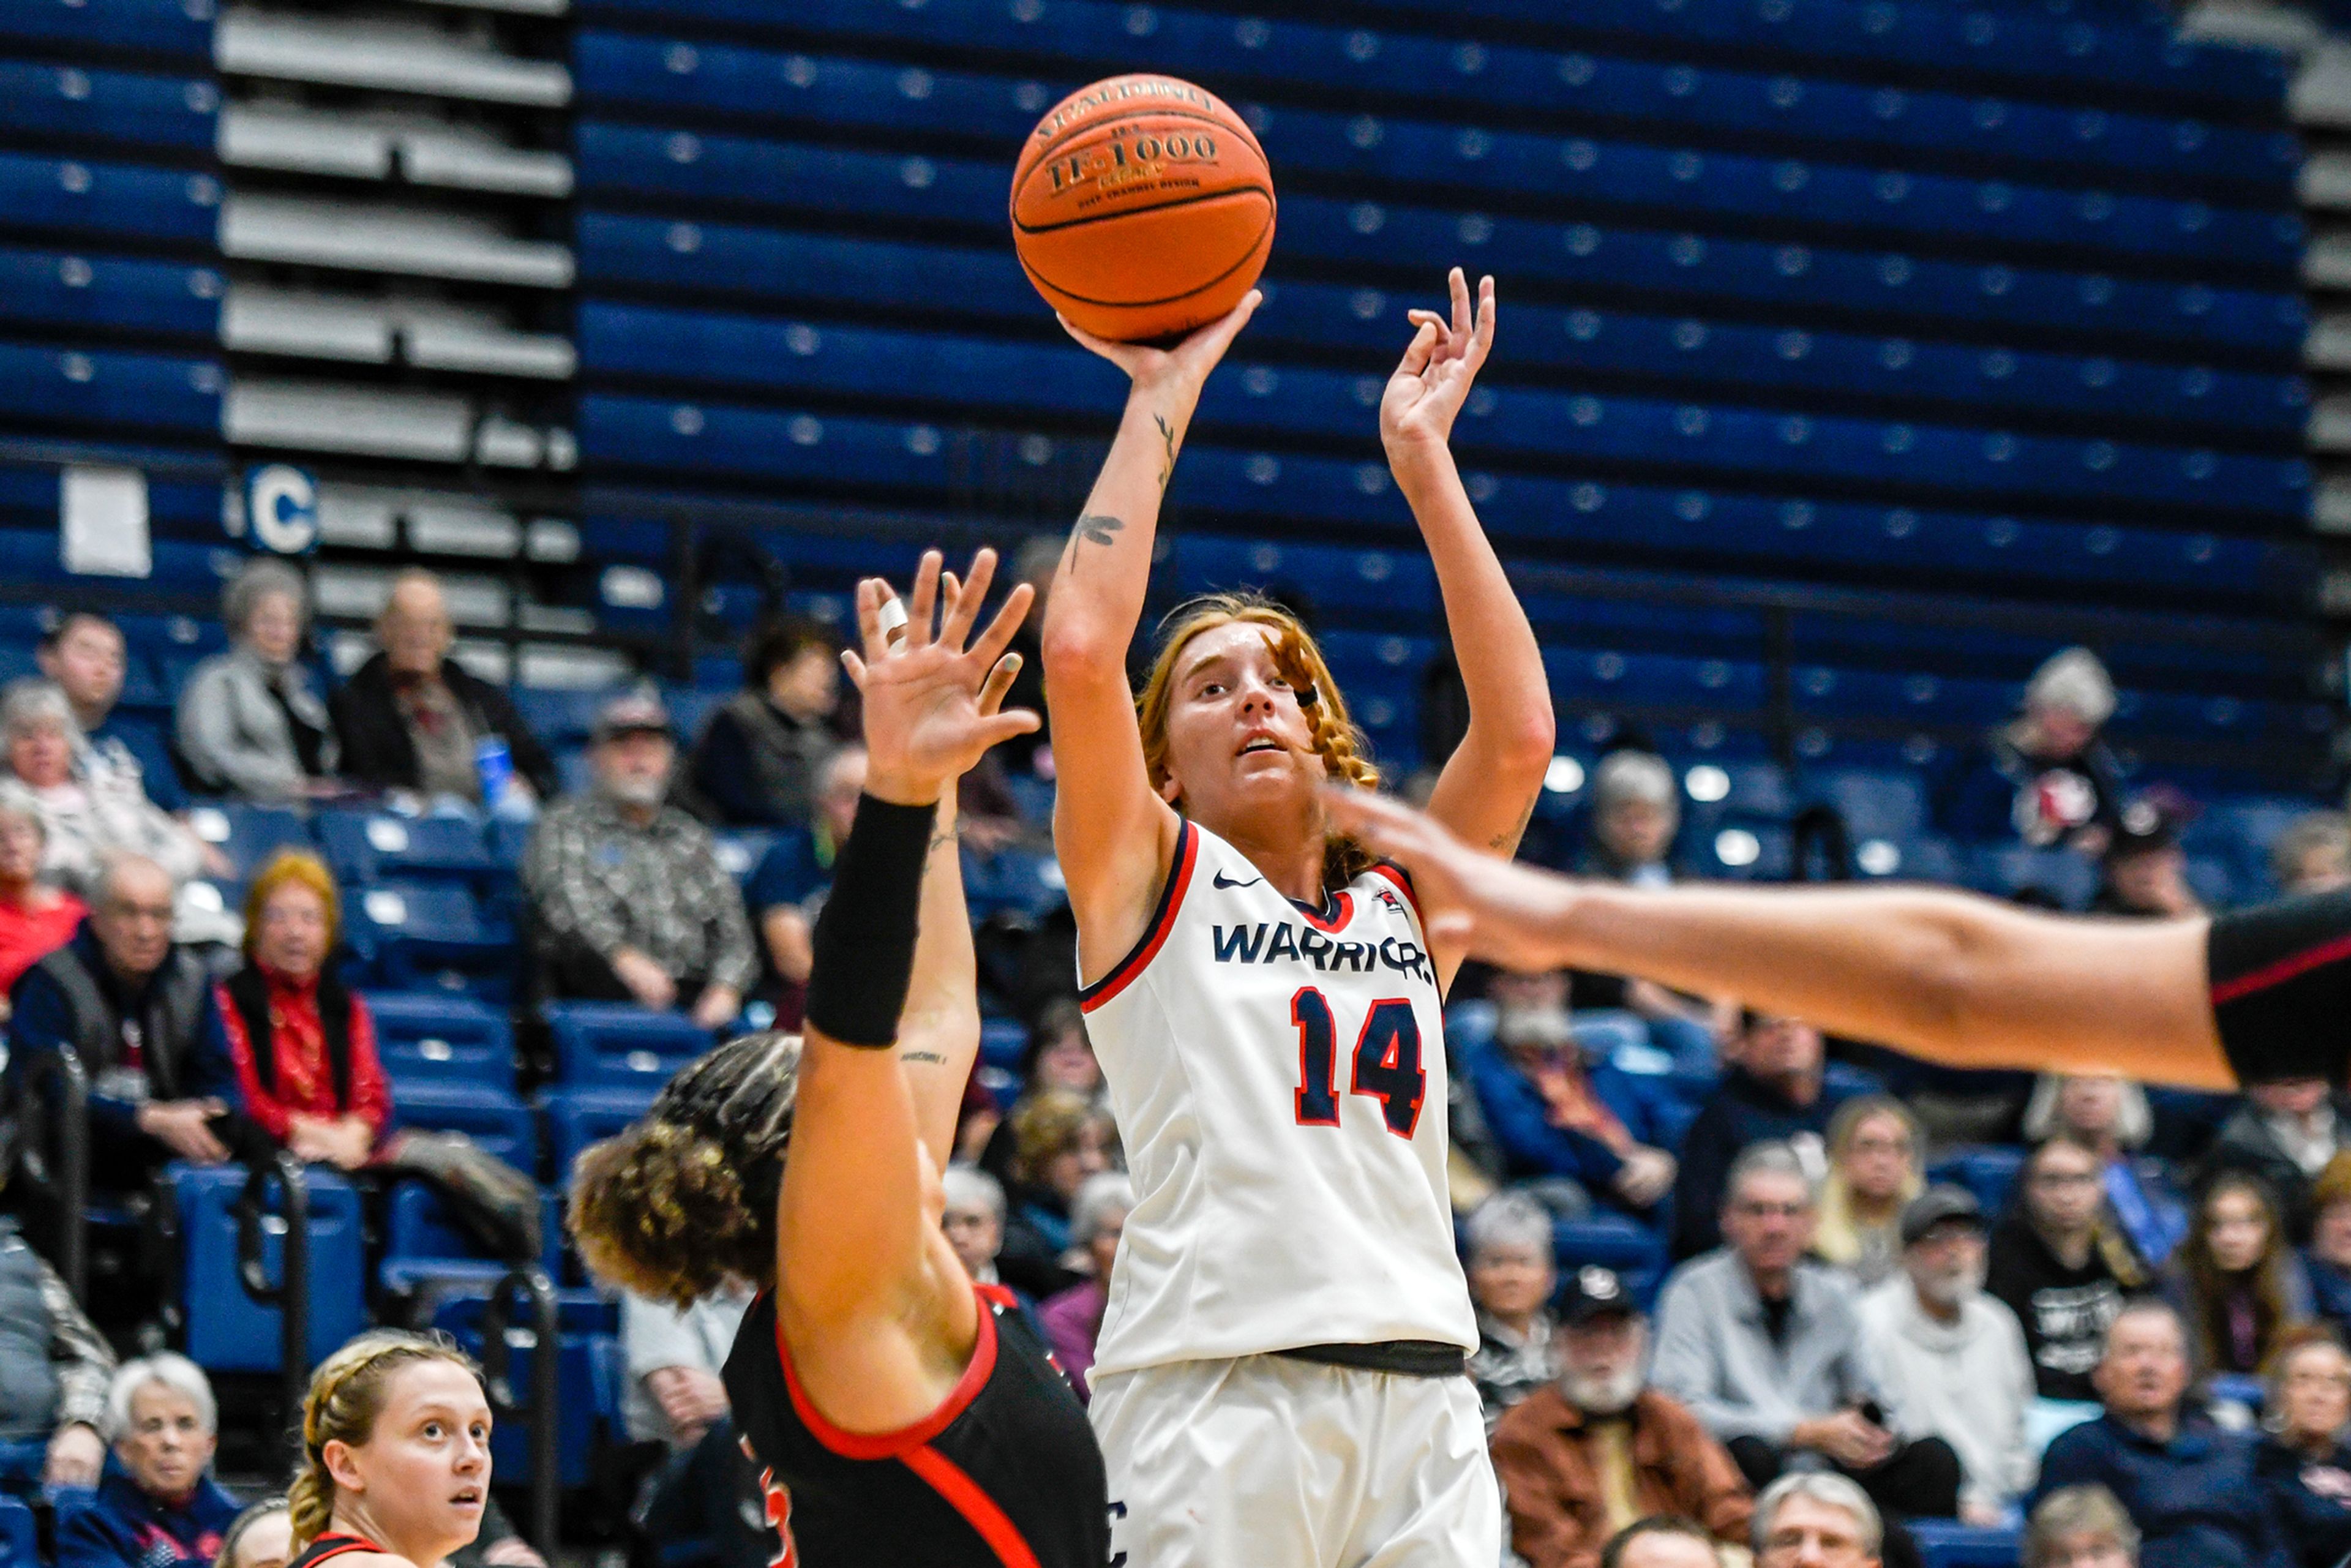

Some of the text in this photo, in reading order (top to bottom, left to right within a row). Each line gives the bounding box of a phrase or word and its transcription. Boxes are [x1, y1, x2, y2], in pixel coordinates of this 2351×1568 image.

[1046, 135, 1217, 192] TF-1000
[250, 463, 314, 553] C
[1289, 986, 1427, 1141] 14
